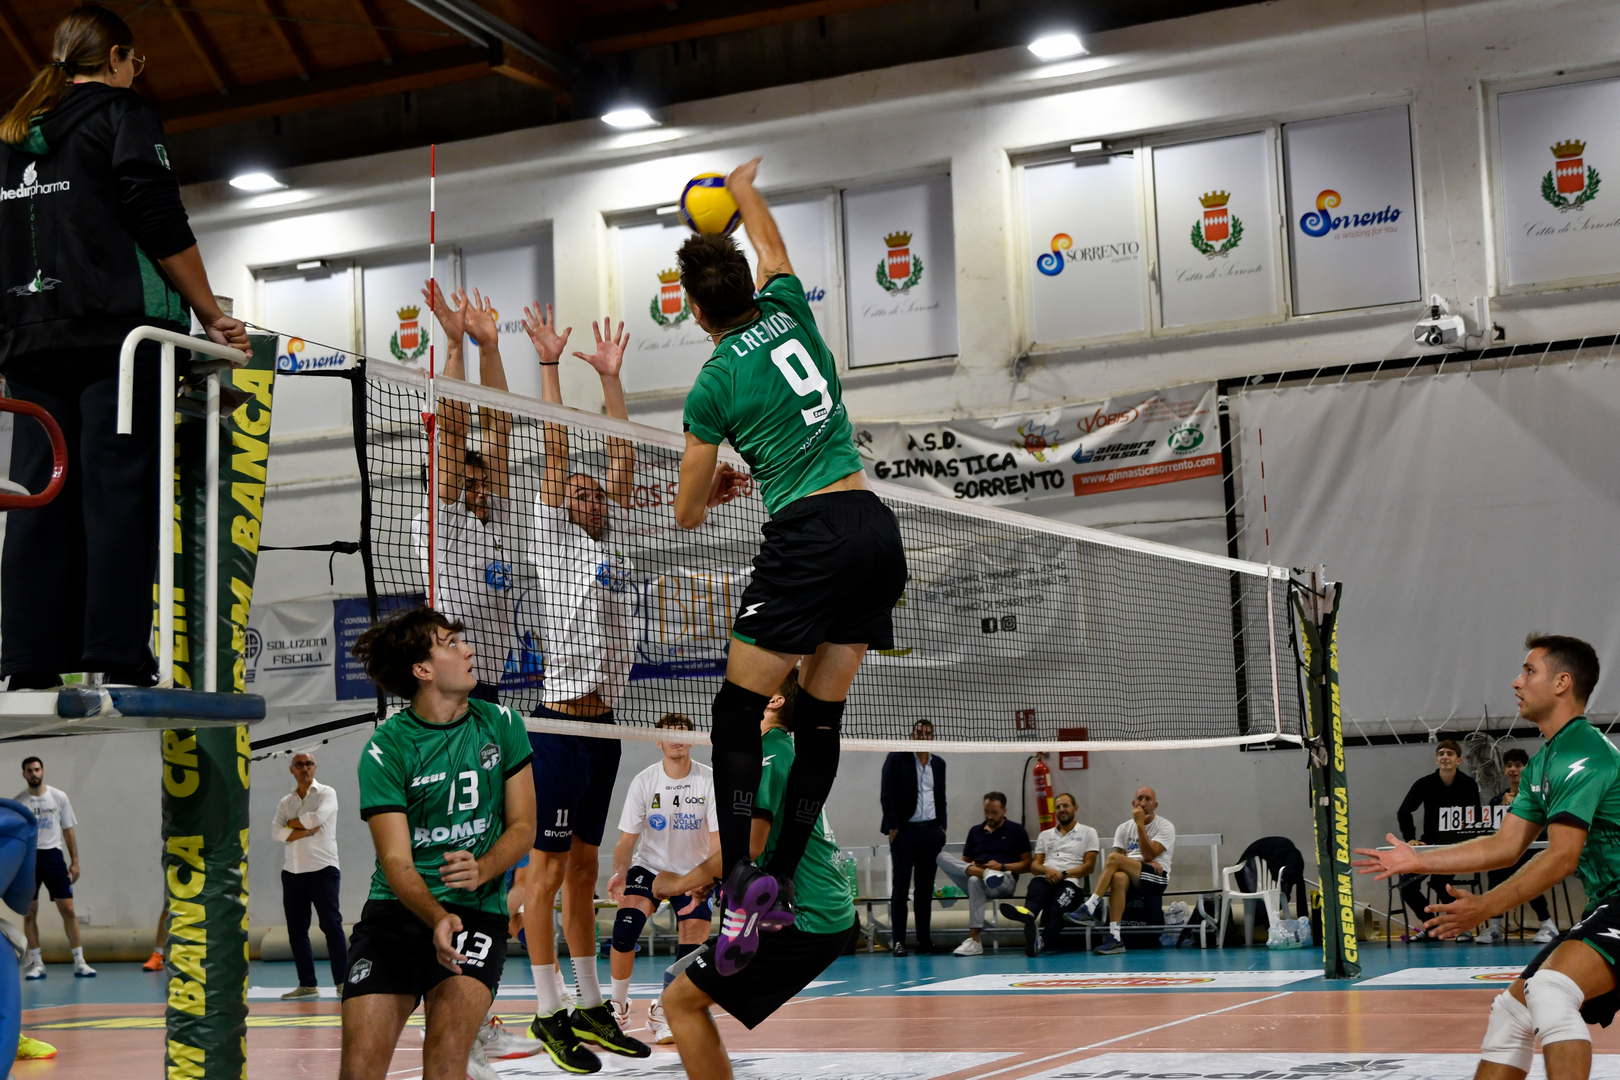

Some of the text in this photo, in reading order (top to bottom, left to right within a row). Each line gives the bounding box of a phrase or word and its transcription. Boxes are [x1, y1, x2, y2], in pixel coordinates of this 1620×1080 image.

[1300, 189, 1403, 238] Sorrento
[1342, 229, 1371, 239] Waiting
[1371, 227, 1383, 237] for
[1383, 225, 1398, 234] You
[1066, 241, 1140, 263] SORRENTO
[277, 337, 347, 372] Sorrento
[770, 338, 834, 426] 9
[1084, 408, 1130, 434] VOBIS
[231, 369, 274, 555] BANCA
[874, 452, 1018, 480] GINNASTICA
[1080, 456, 1216, 485] www.ginnasticasorrento.com
[953, 469, 1065, 499] SORRENTO
[266, 637, 328, 651] SOLUZIONI
[273, 652, 323, 665] FISCALI
[1330, 681, 1345, 773] CREDEM
[447, 770, 480, 816] 13
[672, 795, 680, 808] 4
[555, 808, 569, 827] 11
[673, 818, 704, 826] VOLLEY
[674, 812, 696, 820] TEAM
[1333, 787, 1350, 865] BANCA
[1441, 810, 1460, 829] 18
[1483, 808, 1490, 822] 2
[634, 874, 644, 884] 4
[166, 835, 207, 1016] BANCA
[1337, 873, 1358, 963] CREDEM
[455, 930, 493, 961] 13
